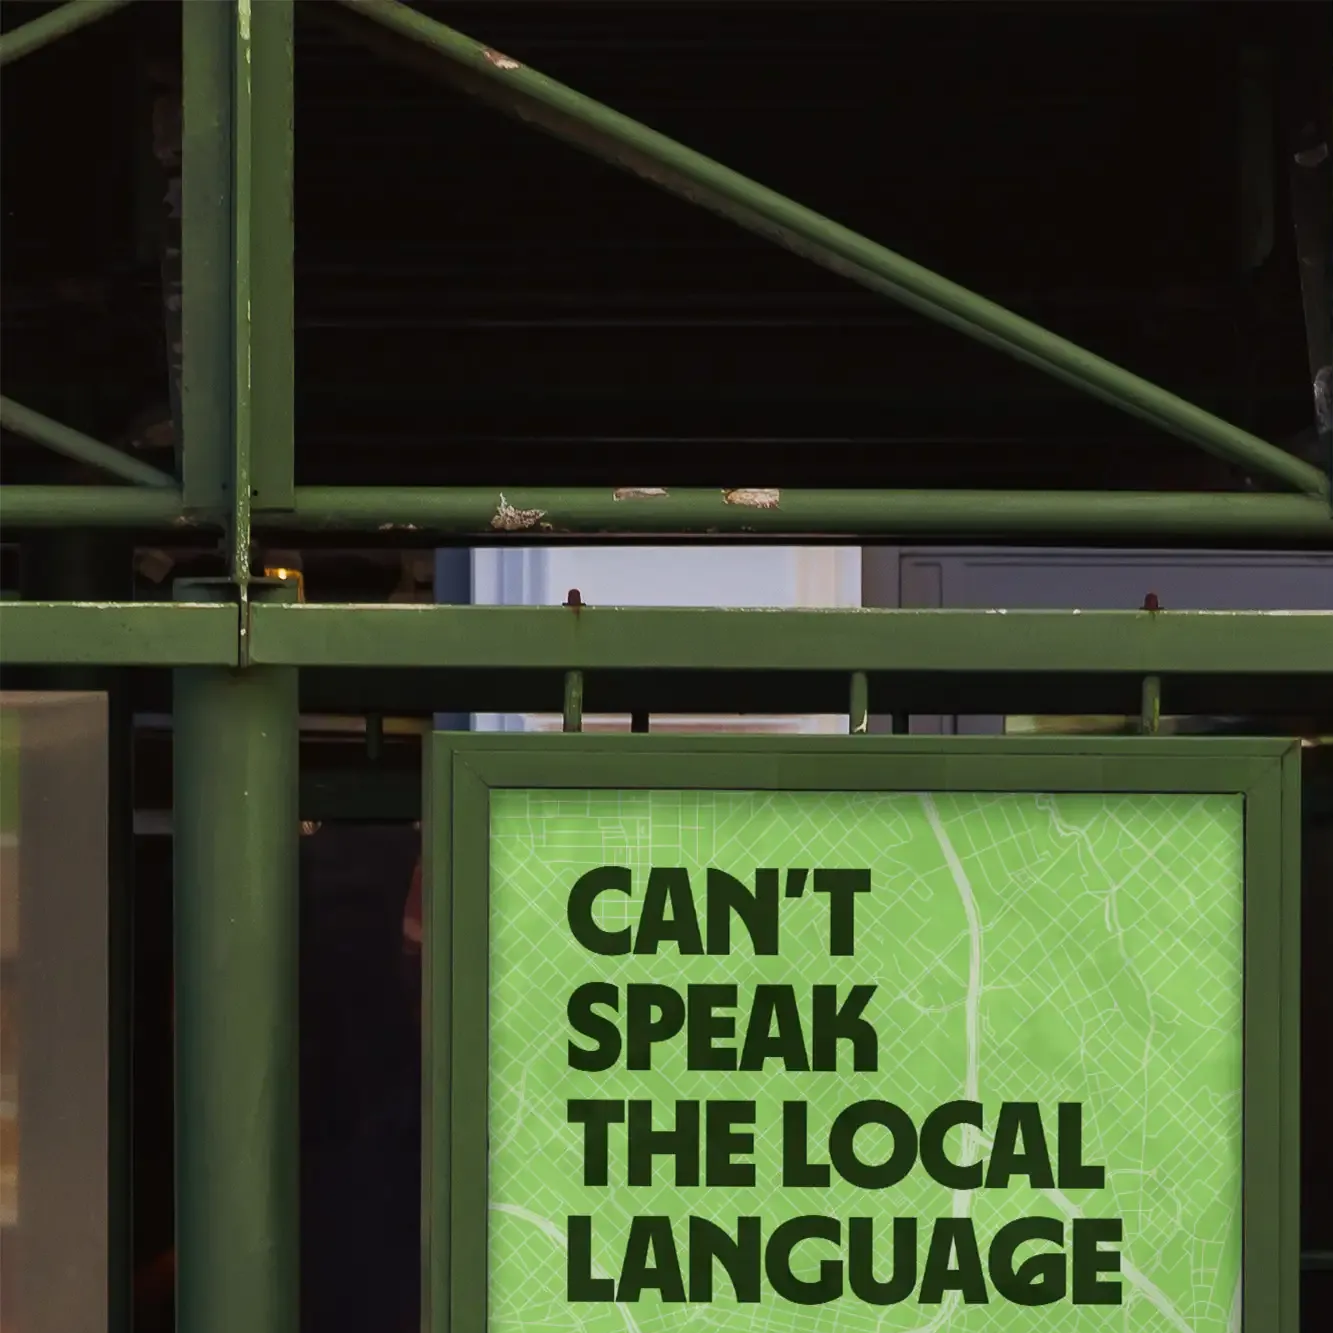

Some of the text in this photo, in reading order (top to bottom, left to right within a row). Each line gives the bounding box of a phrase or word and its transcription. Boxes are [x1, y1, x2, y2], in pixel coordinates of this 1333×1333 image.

[567, 866, 872, 957] CAN'T
[566, 981, 879, 1073] SPEAK
[567, 1099, 1105, 1191] THE LOCAL
[567, 1214, 1123, 1307] LANGUAGE
